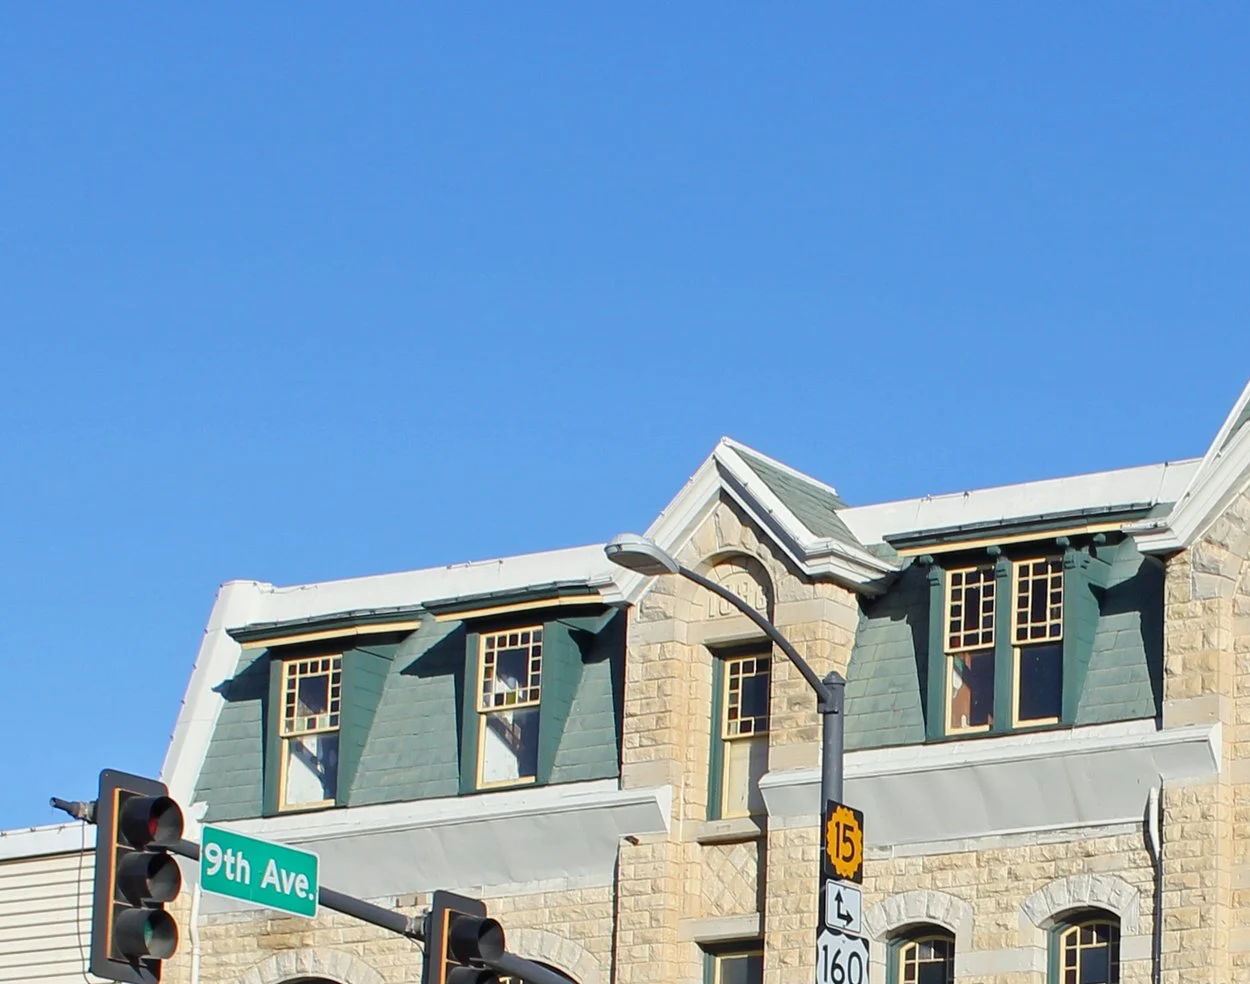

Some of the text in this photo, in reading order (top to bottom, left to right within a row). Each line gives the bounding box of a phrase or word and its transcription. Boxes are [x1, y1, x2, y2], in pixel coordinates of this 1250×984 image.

[834, 820, 855, 863] 15
[204, 842, 315, 901] 9th Ave.
